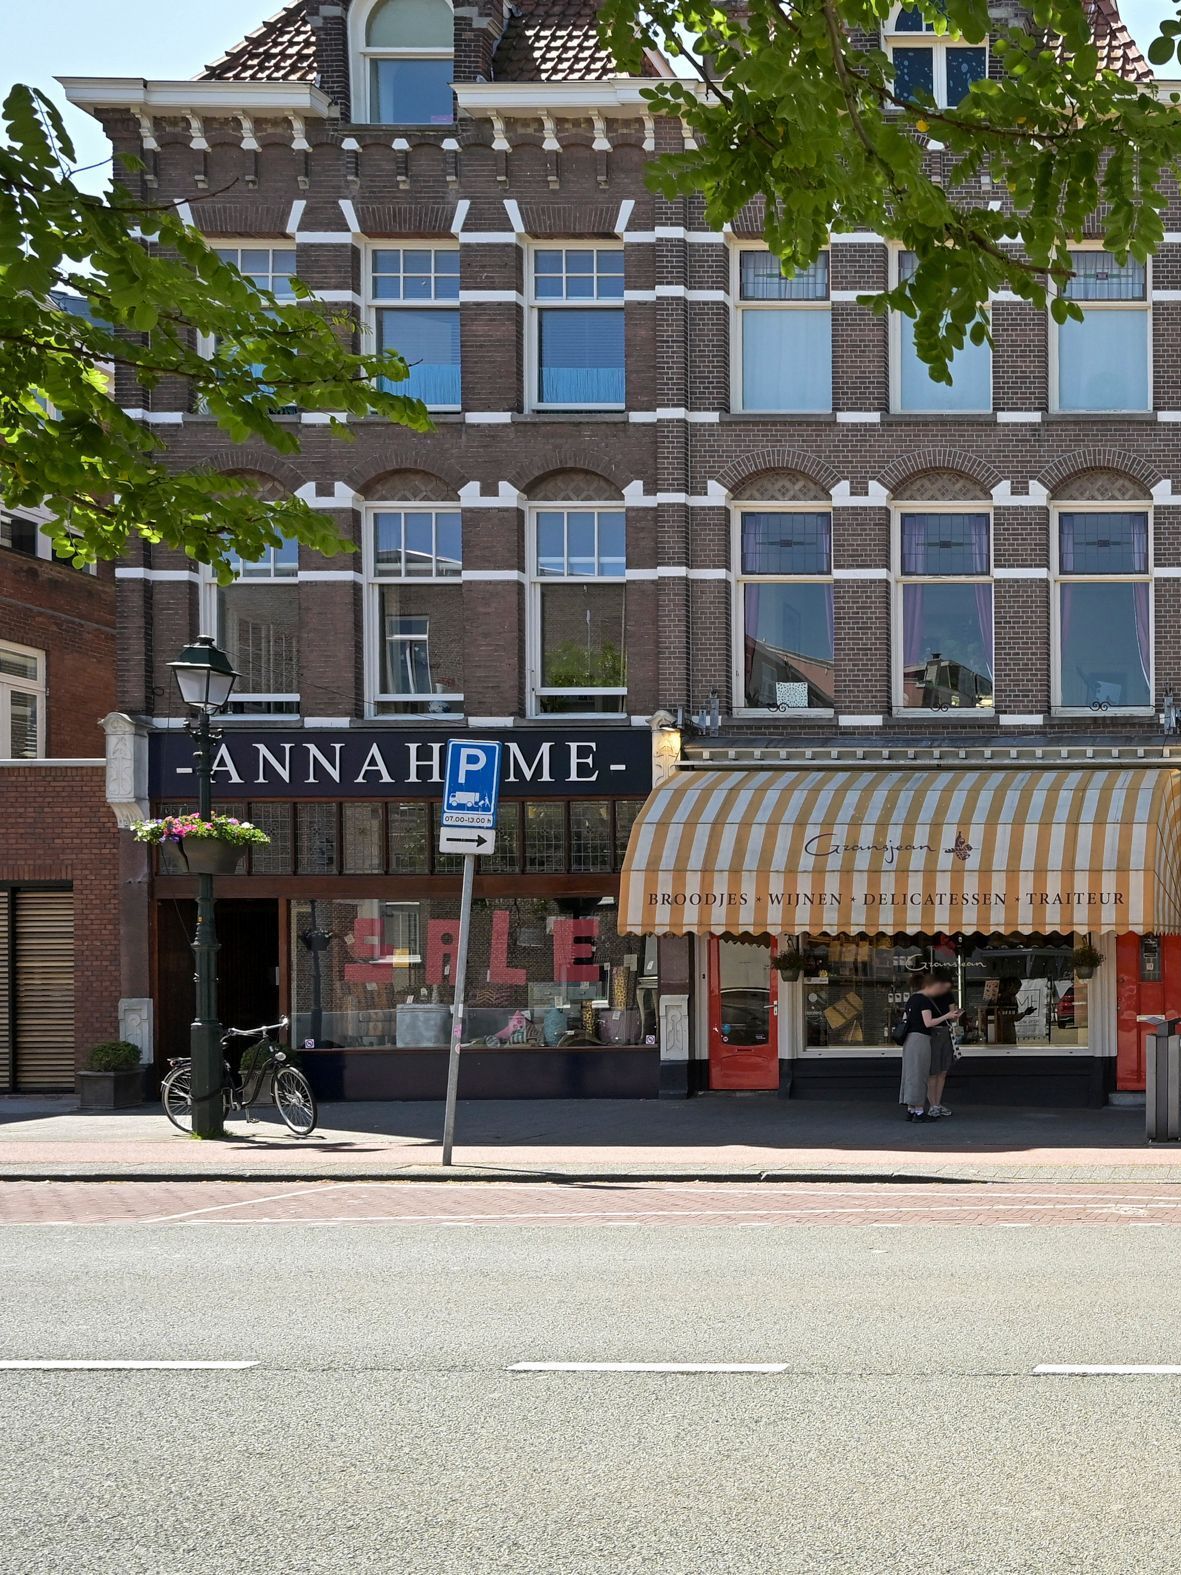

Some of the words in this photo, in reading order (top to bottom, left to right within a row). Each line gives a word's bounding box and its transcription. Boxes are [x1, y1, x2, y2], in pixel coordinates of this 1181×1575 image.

[457, 747, 487, 784] P
[804, 833, 936, 864] Gransjean
[648, 892, 748, 907] BROODJES
[769, 892, 843, 907] WIJNEN
[863, 892, 1007, 906] DELICATESSEN
[1026, 891, 1125, 905] TRAITEUR
[344, 910, 600, 985] SALE
